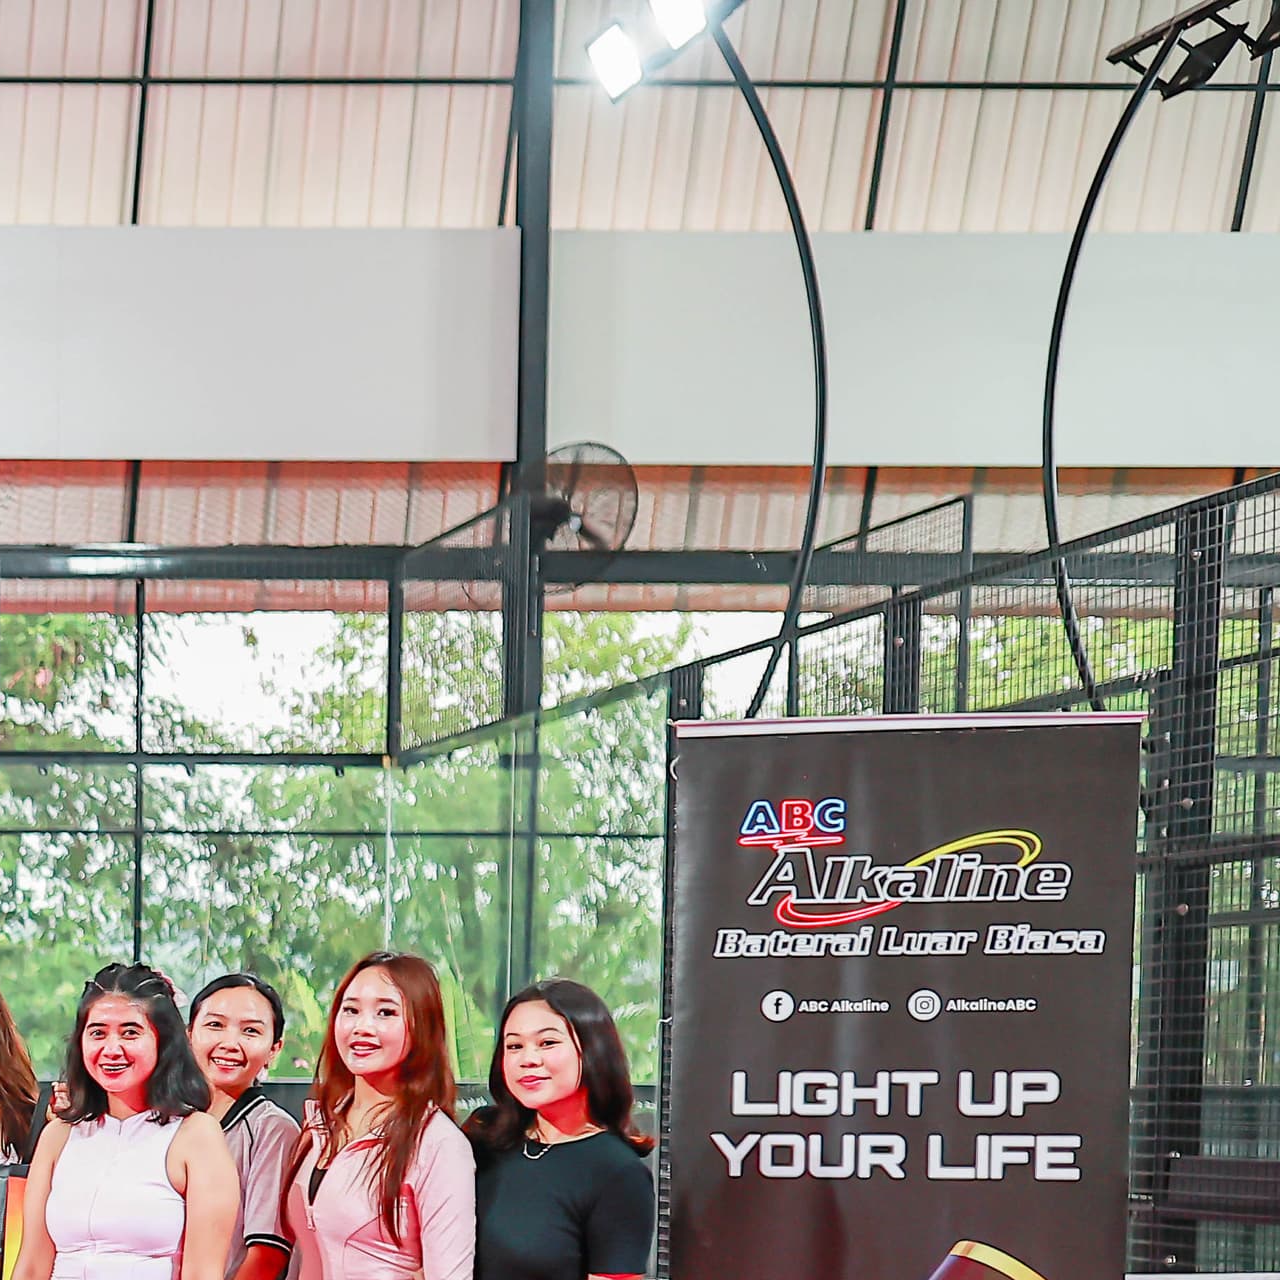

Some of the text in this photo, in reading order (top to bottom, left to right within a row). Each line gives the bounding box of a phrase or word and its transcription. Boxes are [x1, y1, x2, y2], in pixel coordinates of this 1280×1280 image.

[740, 799, 847, 834] ABC
[747, 847, 1071, 904] Alkaline
[713, 924, 1105, 957] Baterai Luar Biasa
[798, 999, 889, 1013] ABC Alkaline
[945, 998, 1036, 1012] AlkalineABC
[732, 1070, 1060, 1117] LIGHT UP
[710, 1133, 1081, 1181] YOUR LIFE
